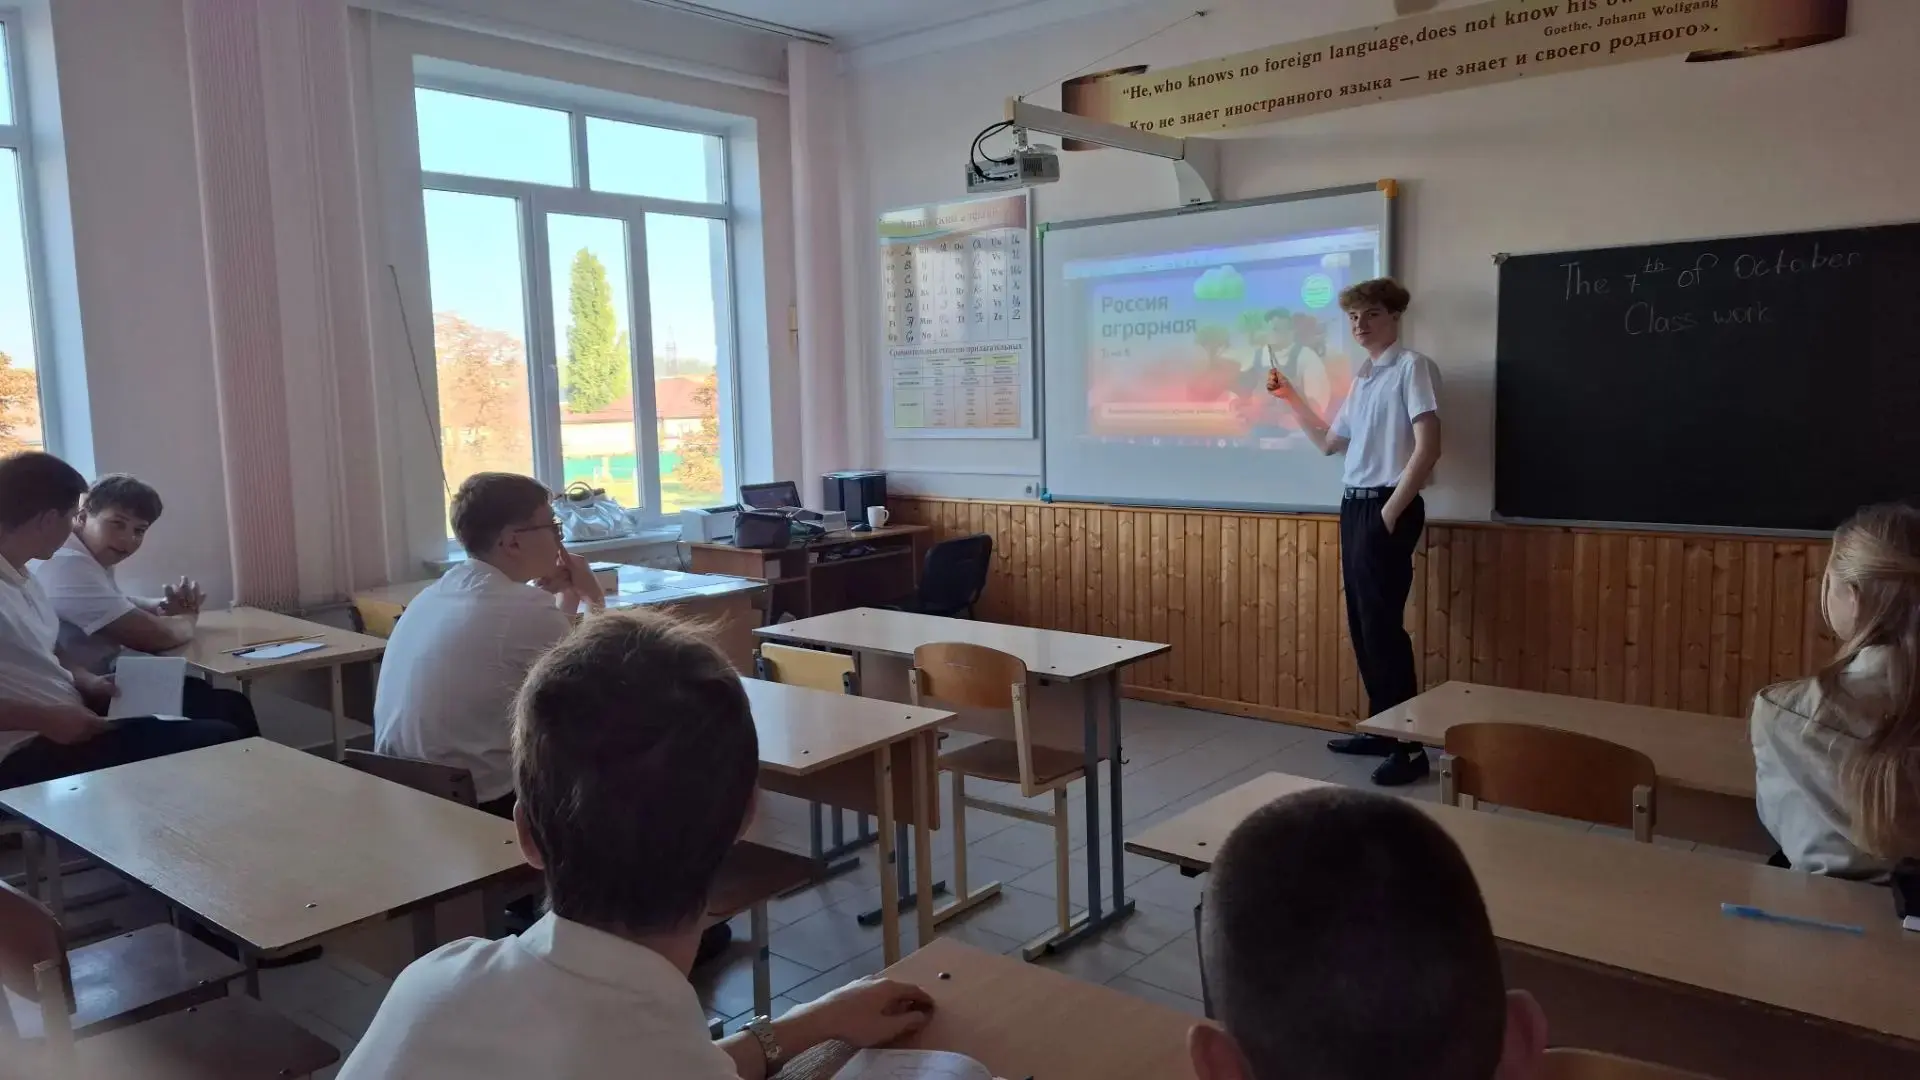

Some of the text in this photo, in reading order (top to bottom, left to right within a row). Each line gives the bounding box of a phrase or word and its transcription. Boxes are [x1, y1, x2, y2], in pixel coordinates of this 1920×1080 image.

[1544, 0, 1719, 37] Goethe, Johann Wolfgang
[1188, 67, 1234, 87] knows
[1240, 64, 1259, 76] no
[1265, 51, 1322, 72] foreign
[1465, 15, 1497, 33] not
[1505, 4, 1559, 26] know
[1567, 0, 1597, 14] his
[1159, 115, 1175, 128] не
[1180, 108, 1219, 125] знает
[1225, 86, 1333, 117] иностранного
[1339, 76, 1393, 97] языка
[1427, 66, 1448, 81] не
[1455, 57, 1507, 76] знает
[1515, 53, 1528, 66] и
[1535, 40, 1601, 63] своего
[1559, 260, 1611, 301] The
[1677, 252, 1720, 288] of
[1734, 242, 1862, 280] October
[1102, 296, 1168, 314] Россия
[1624, 301, 1773, 335] Class work
[1102, 319, 1197, 341] аграрная
